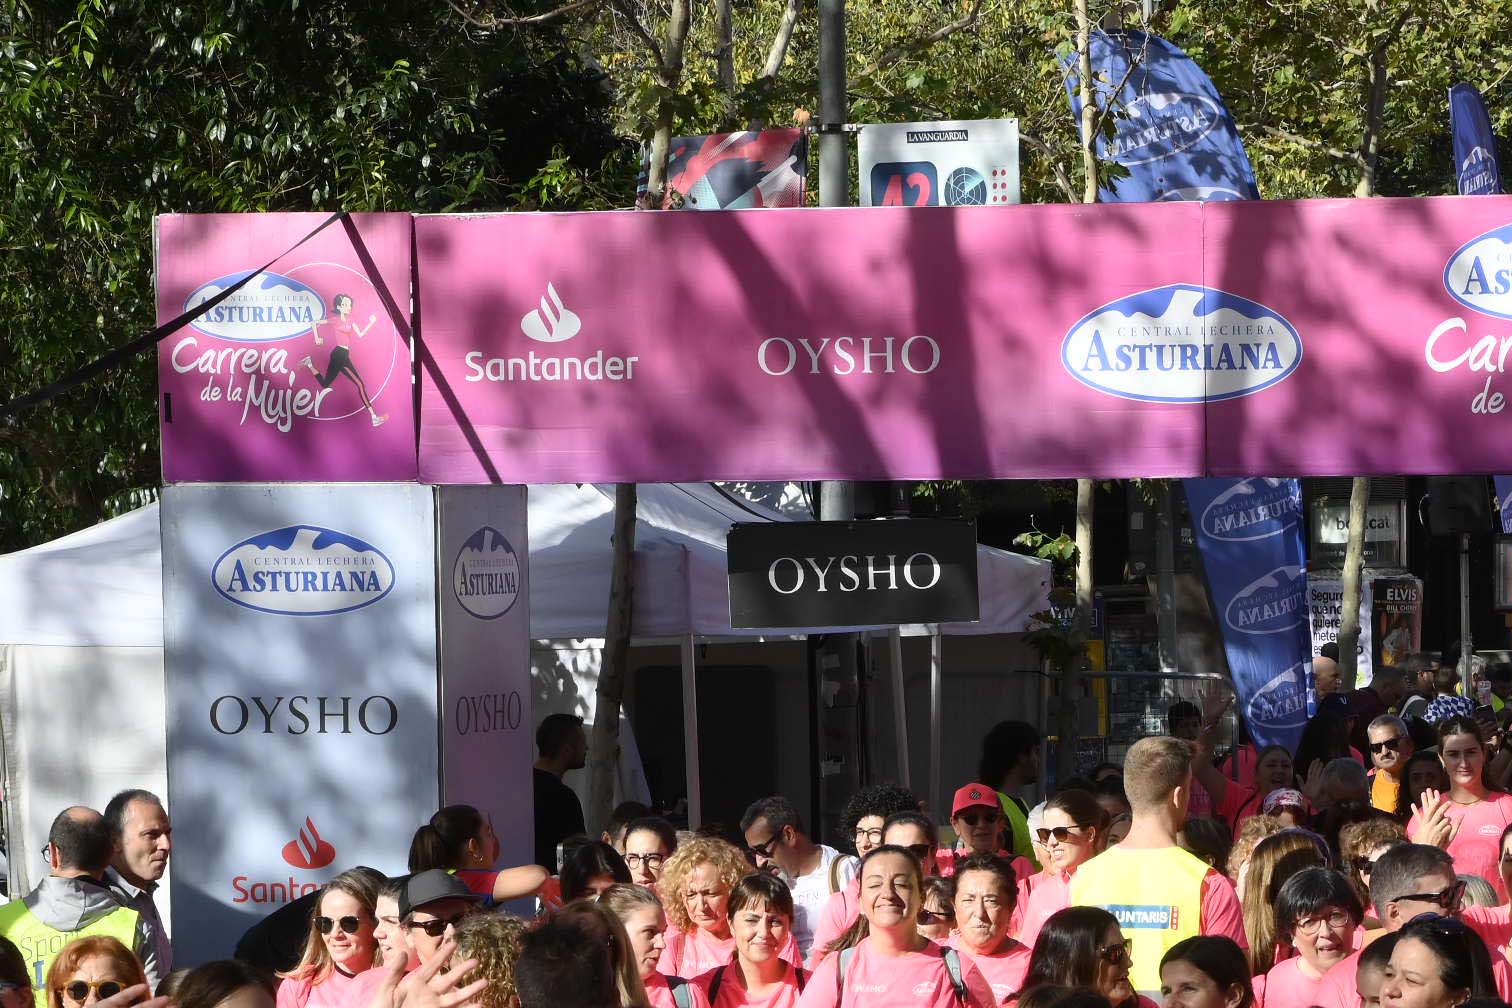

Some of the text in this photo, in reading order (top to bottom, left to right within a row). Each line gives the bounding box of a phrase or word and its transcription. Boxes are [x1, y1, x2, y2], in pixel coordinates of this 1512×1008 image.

[1117, 324, 1275, 337] CENTRAL LECHERA
[172, 337, 290, 374] Carrera
[465, 350, 639, 383] Santander
[757, 335, 941, 376] OYSHO
[1082, 329, 1284, 372] ASTURIANA
[200, 369, 333, 433] de la Mujer
[1471, 376, 1505, 415] de
[227, 559, 382, 592] ASTURIANA
[254, 556, 376, 566] CENTRAL LECHERA
[458, 560, 517, 596] ASTURIANA
[768, 551, 941, 595] OYSHO
[1386, 588, 1418, 601] ELVIS
[1312, 616, 1342, 629] quiere
[1313, 630, 1338, 642] mete
[209, 694, 399, 736] OYSHO
[456, 691, 522, 736] OYSHO
[232, 876, 330, 904] Santa
[1114, 910, 1168, 924] UNTARIS
